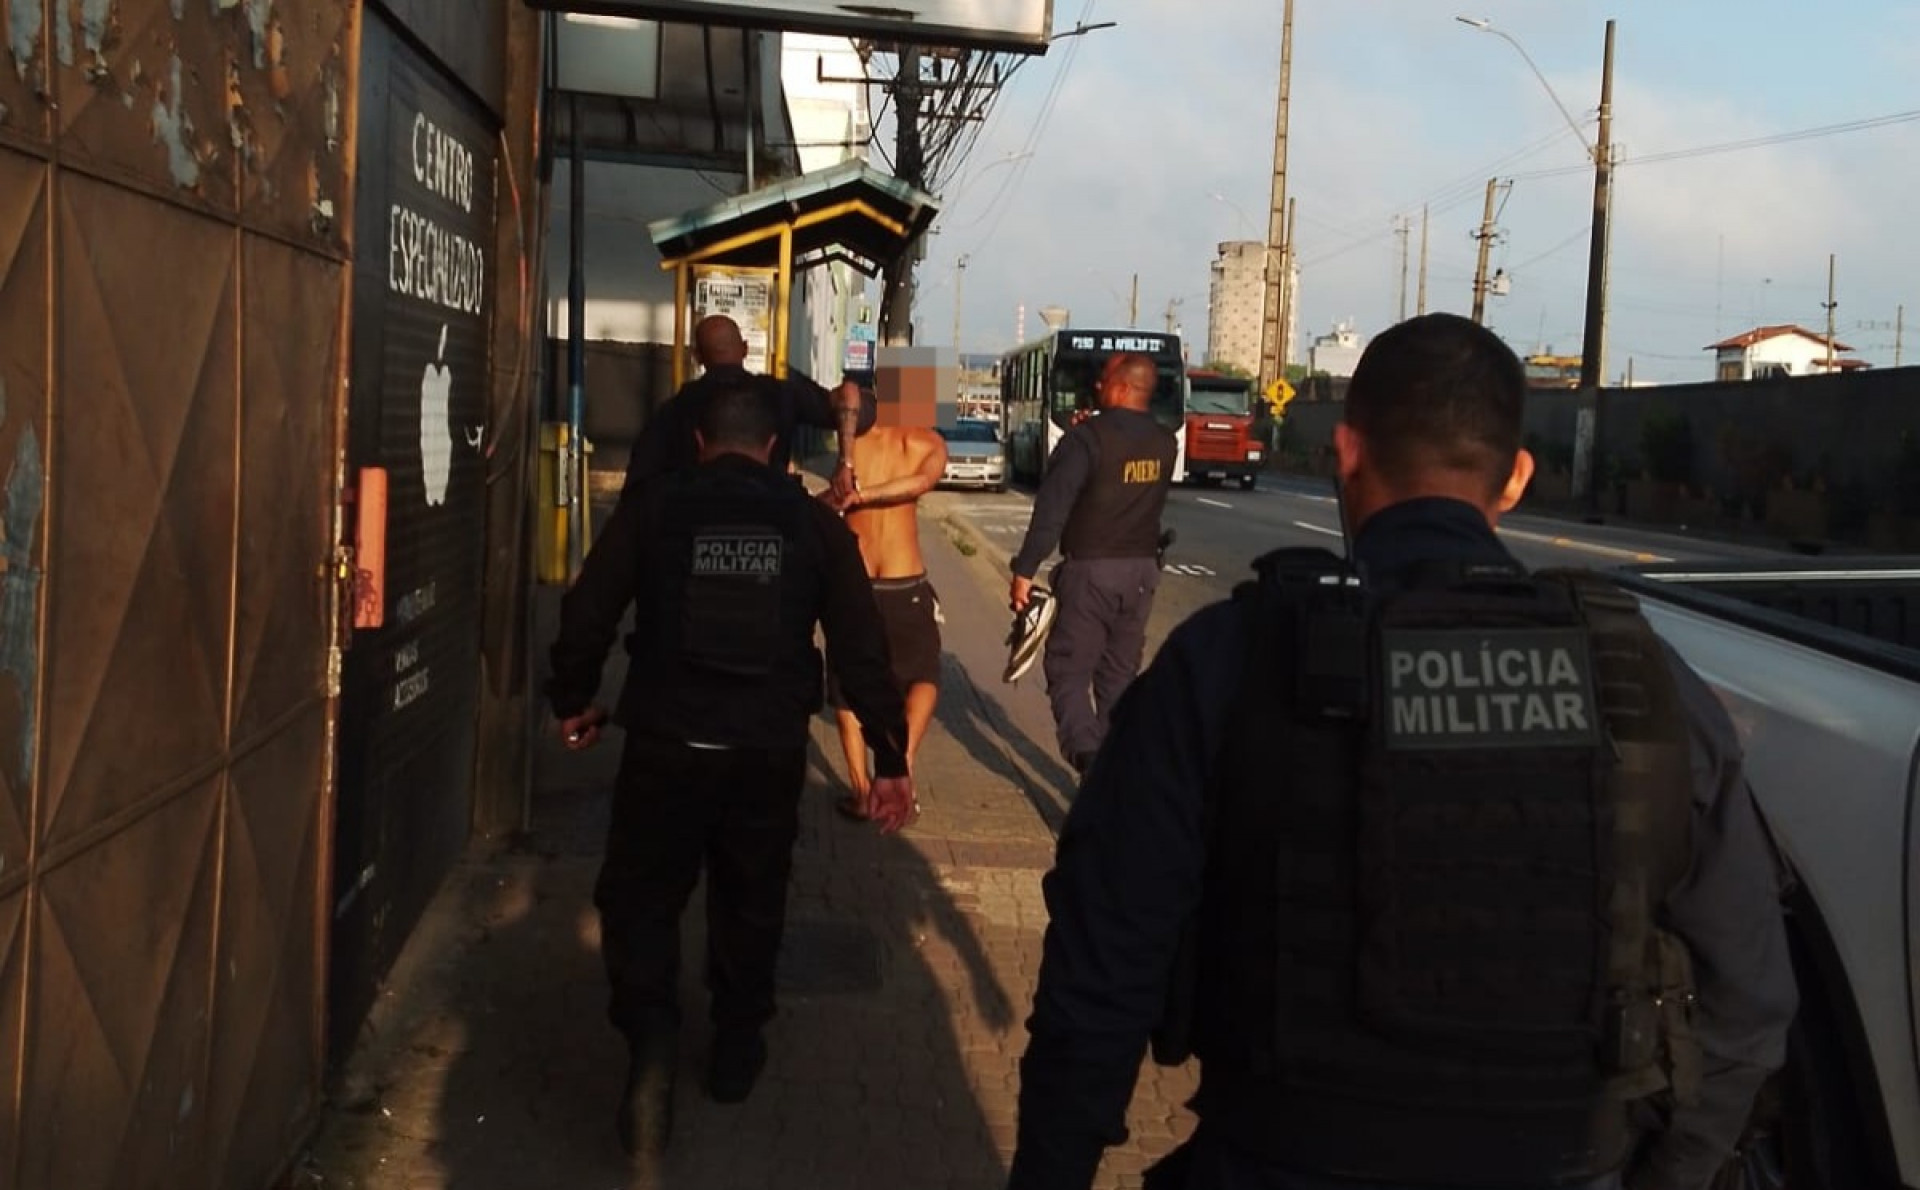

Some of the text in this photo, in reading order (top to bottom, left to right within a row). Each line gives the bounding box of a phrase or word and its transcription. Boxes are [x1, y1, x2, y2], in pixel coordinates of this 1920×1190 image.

[412, 112, 473, 213] CENTRO
[389, 204, 484, 315] ESPECIALIZADO
[695, 556, 777, 571] MILITAR
[1390, 640, 1580, 687] POLÍCIA
[1392, 691, 1588, 733] MILITAR
